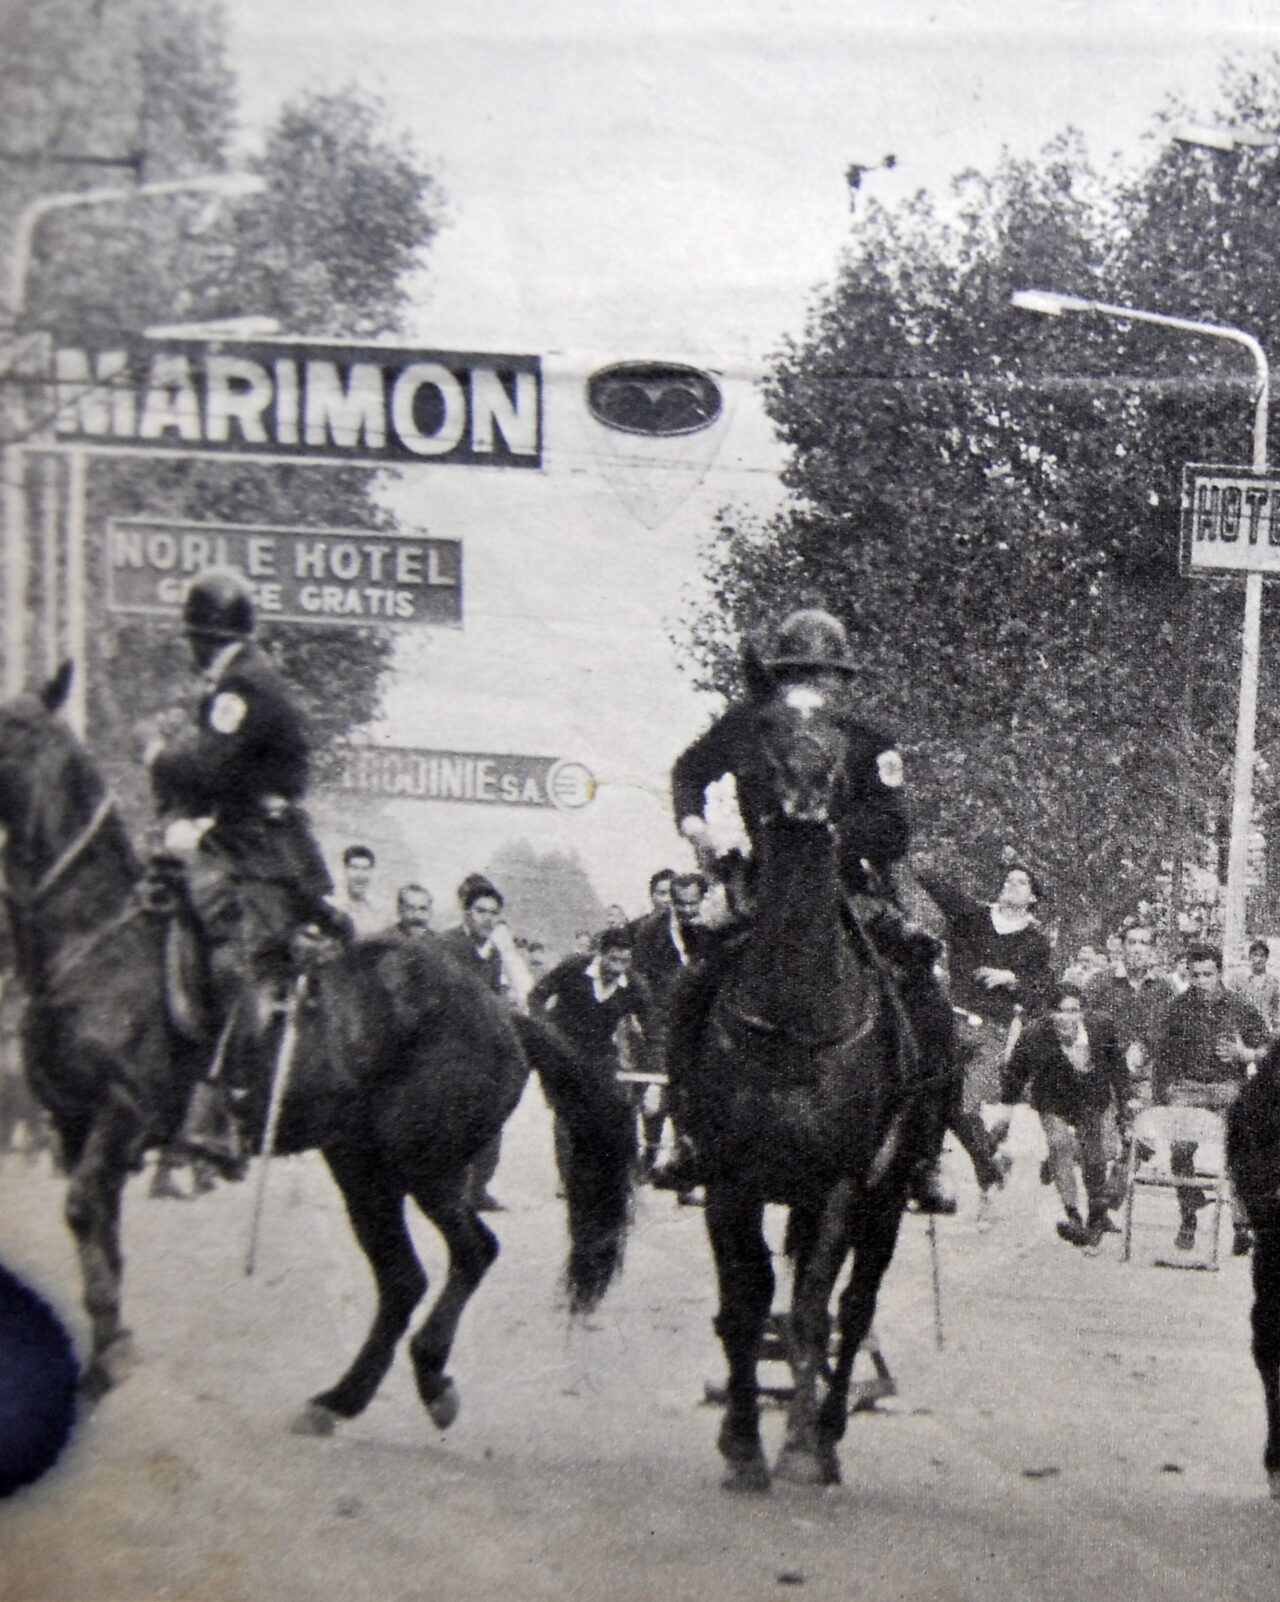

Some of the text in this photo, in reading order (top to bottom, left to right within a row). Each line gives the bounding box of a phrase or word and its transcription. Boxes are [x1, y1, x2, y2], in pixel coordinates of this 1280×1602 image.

[55, 348, 538, 457] MARIMON
[295, 541, 456, 586] HOTEL
[300, 585, 416, 618] GRATIS
